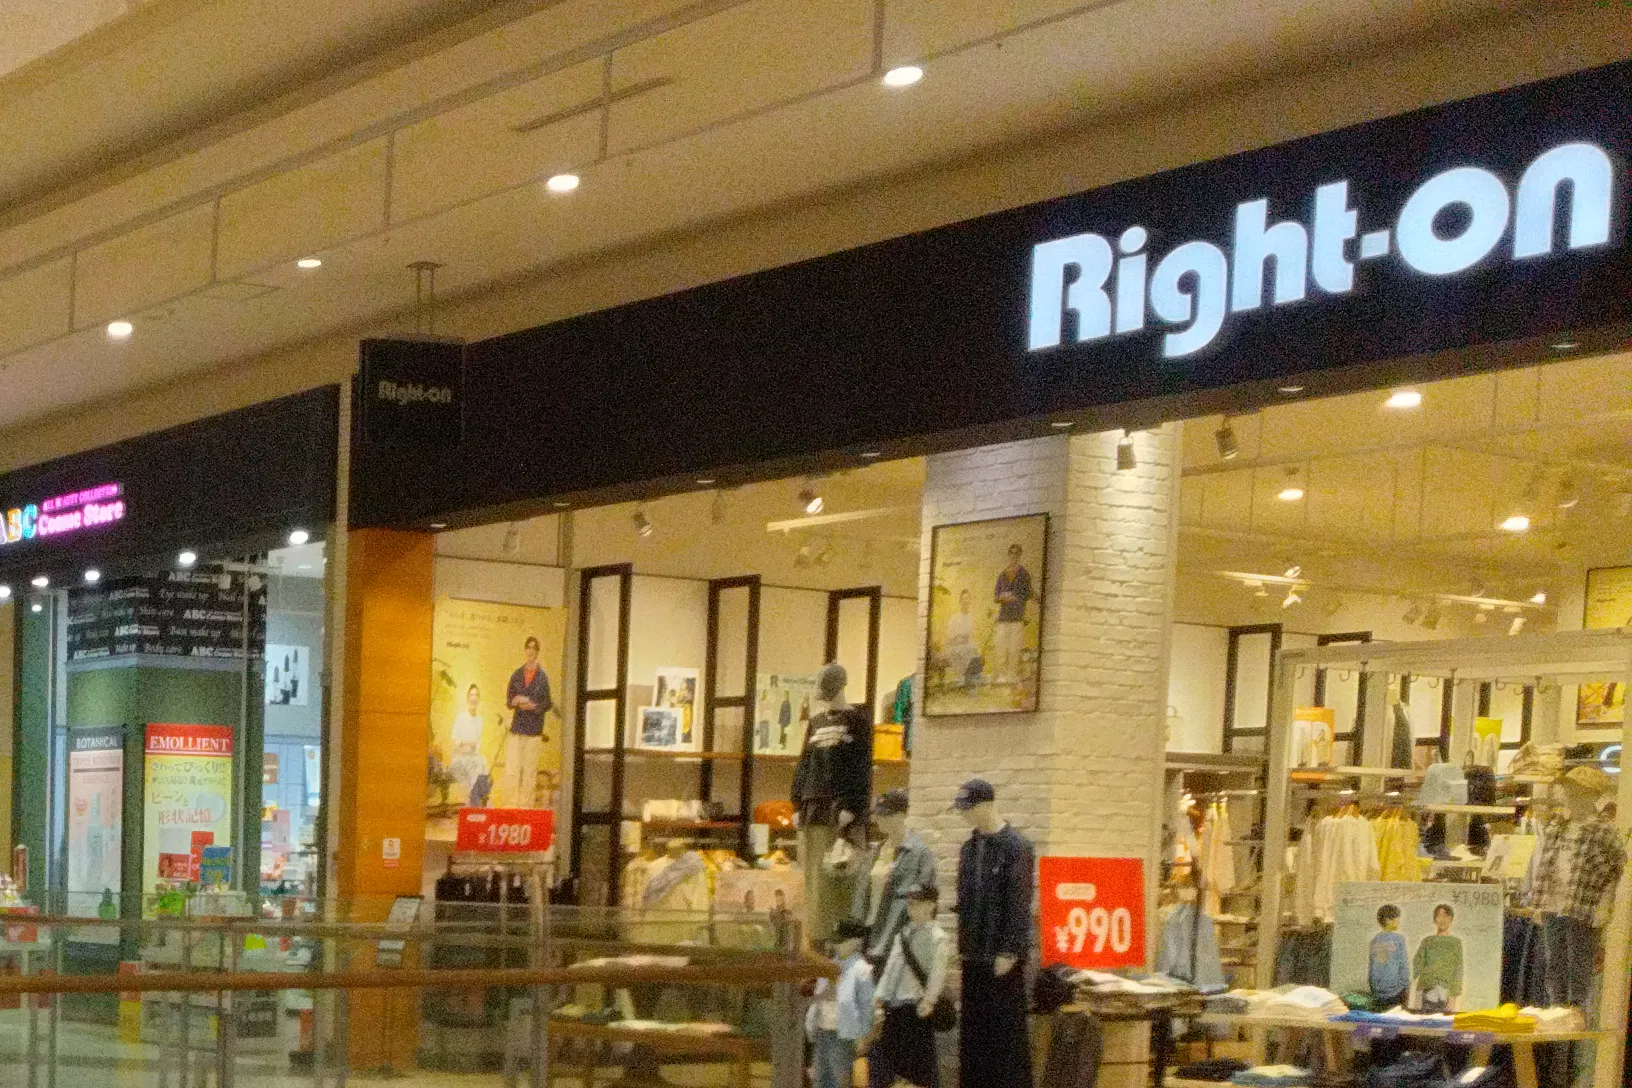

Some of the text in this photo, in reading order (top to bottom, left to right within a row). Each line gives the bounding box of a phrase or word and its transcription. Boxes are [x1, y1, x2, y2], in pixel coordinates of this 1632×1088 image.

[1027, 141, 1614, 359] Right-on
[83, 500, 126, 527] Store
[76, 735, 119, 750] BOTANICAL
[150, 735, 230, 751] EMOLLIENT
[1052, 906, 1132, 954] ¥990
